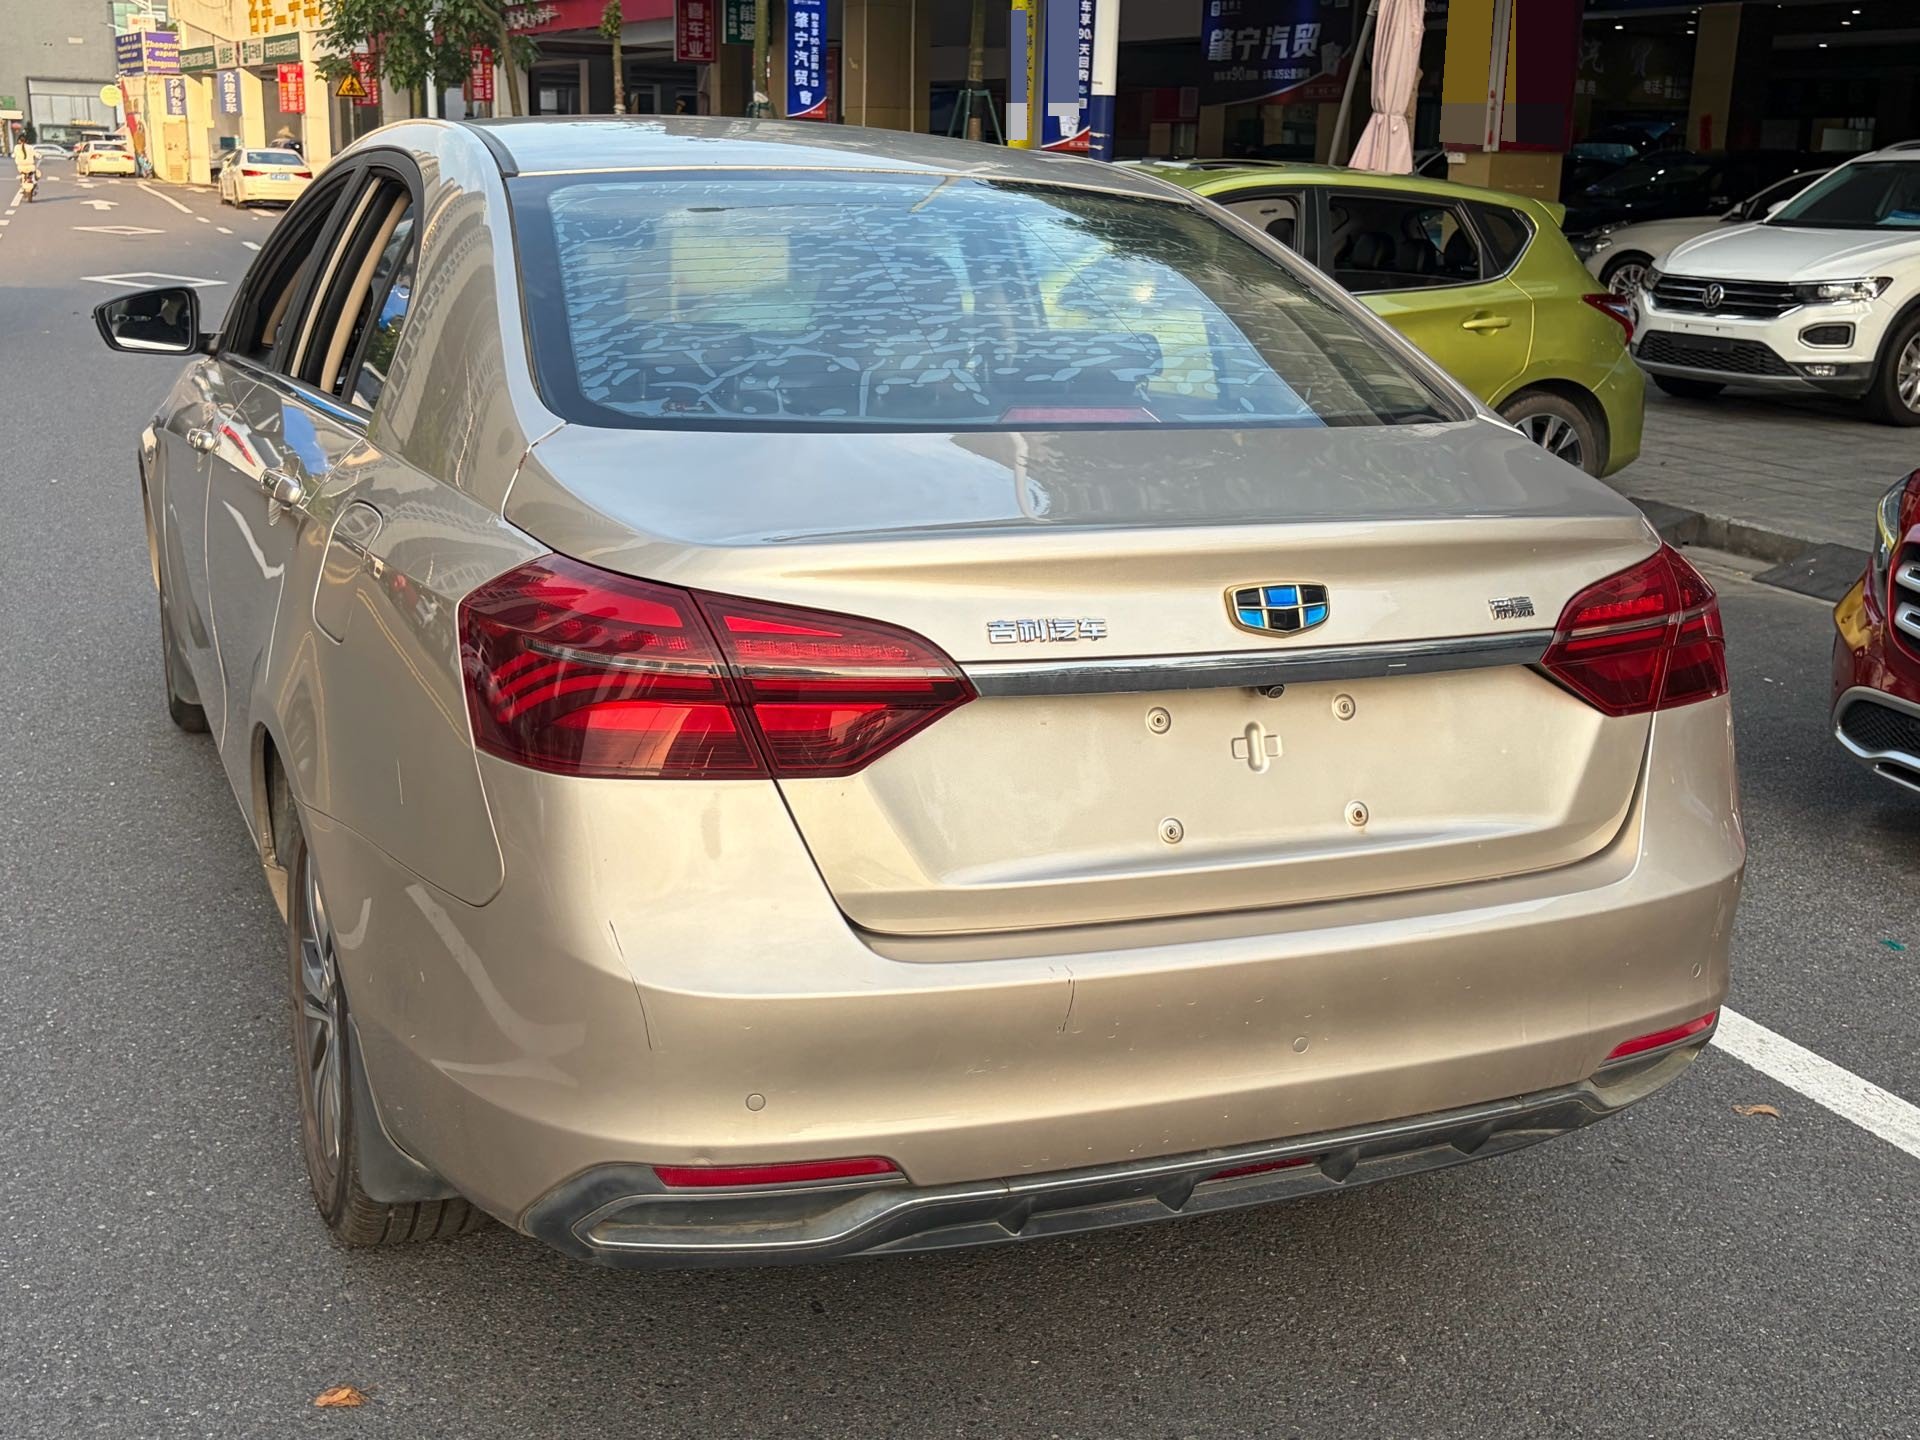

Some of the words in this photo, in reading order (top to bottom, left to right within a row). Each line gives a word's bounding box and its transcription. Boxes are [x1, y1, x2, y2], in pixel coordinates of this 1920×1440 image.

[794, 11, 809, 87] 肇宁汽贸
[1207, 23, 1321, 61] 肇宁汽贸
[987, 618, 1107, 644] 吉利汽车
